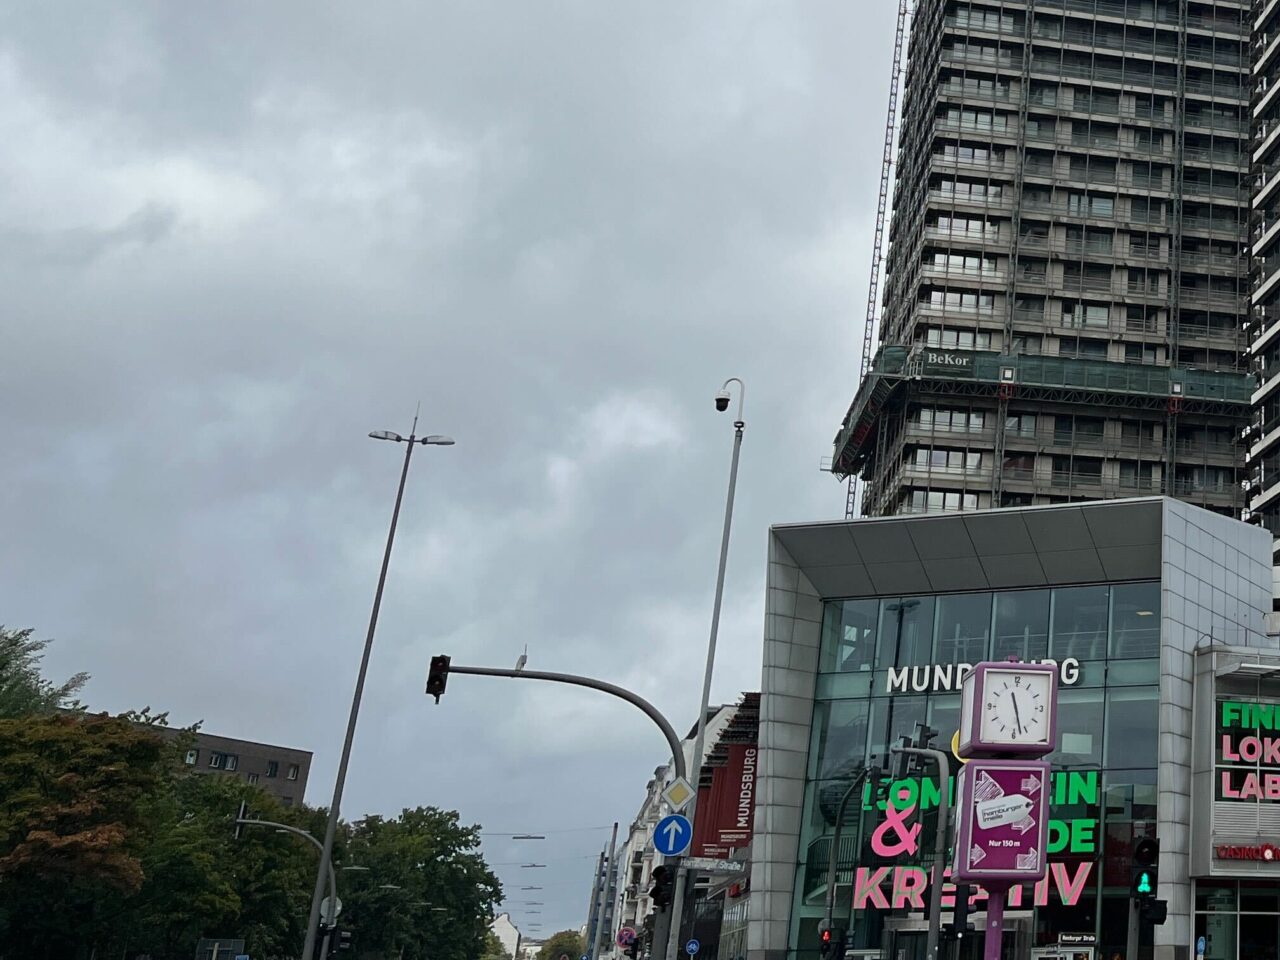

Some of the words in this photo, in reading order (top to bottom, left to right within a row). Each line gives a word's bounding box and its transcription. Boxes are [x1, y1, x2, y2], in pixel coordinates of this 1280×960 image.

[928, 352, 970, 366] BeKor
[886, 657, 1080, 693] MUNDG
[736, 748, 757, 827] MUNDSBURG
